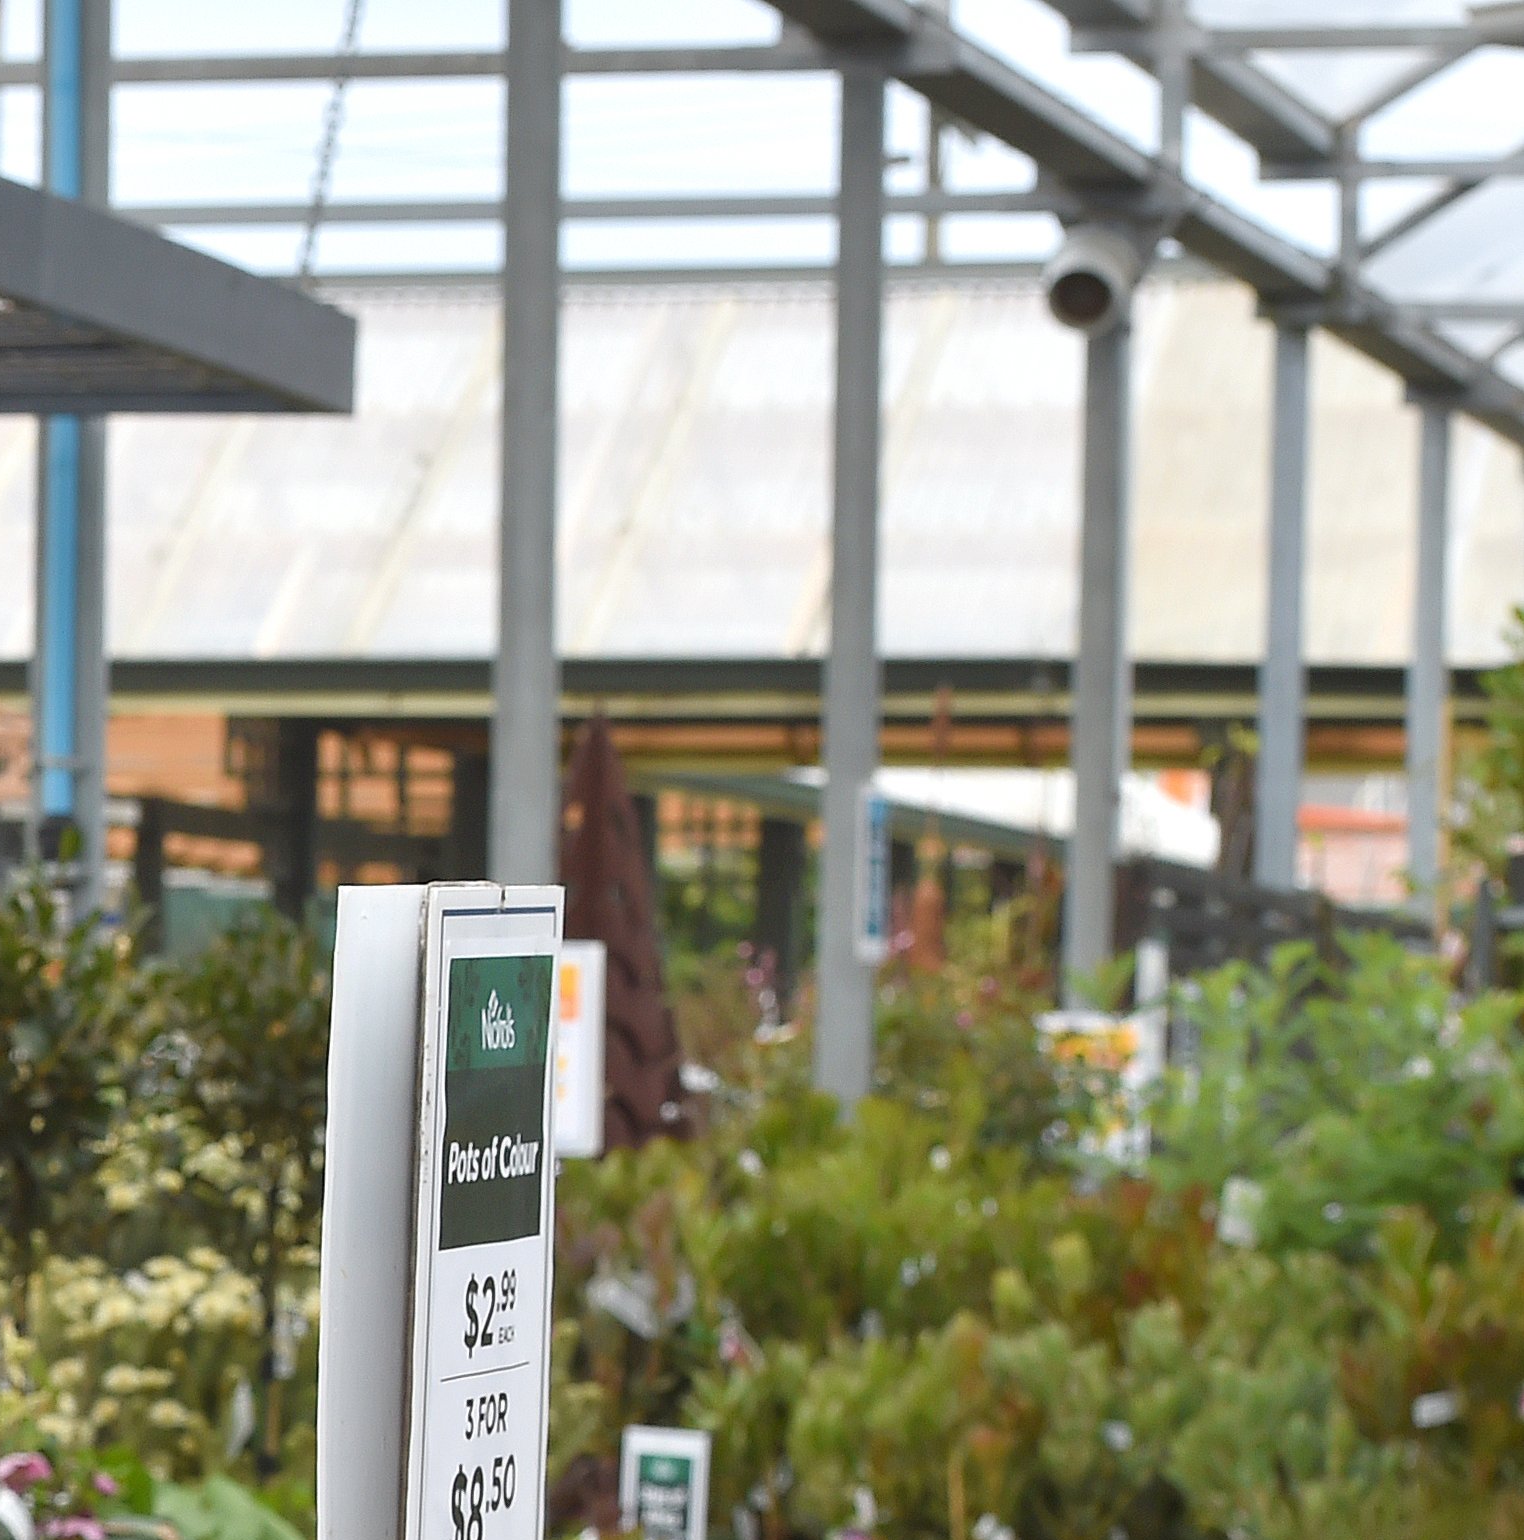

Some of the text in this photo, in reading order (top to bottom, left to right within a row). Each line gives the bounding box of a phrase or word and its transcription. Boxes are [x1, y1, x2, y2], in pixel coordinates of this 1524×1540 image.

[447, 1132, 540, 1185] Pots of Colour
[464, 1268, 517, 1359] $2.99
[498, 1326, 515, 1344] EACH
[464, 1392, 509, 1441] 3 FOR
